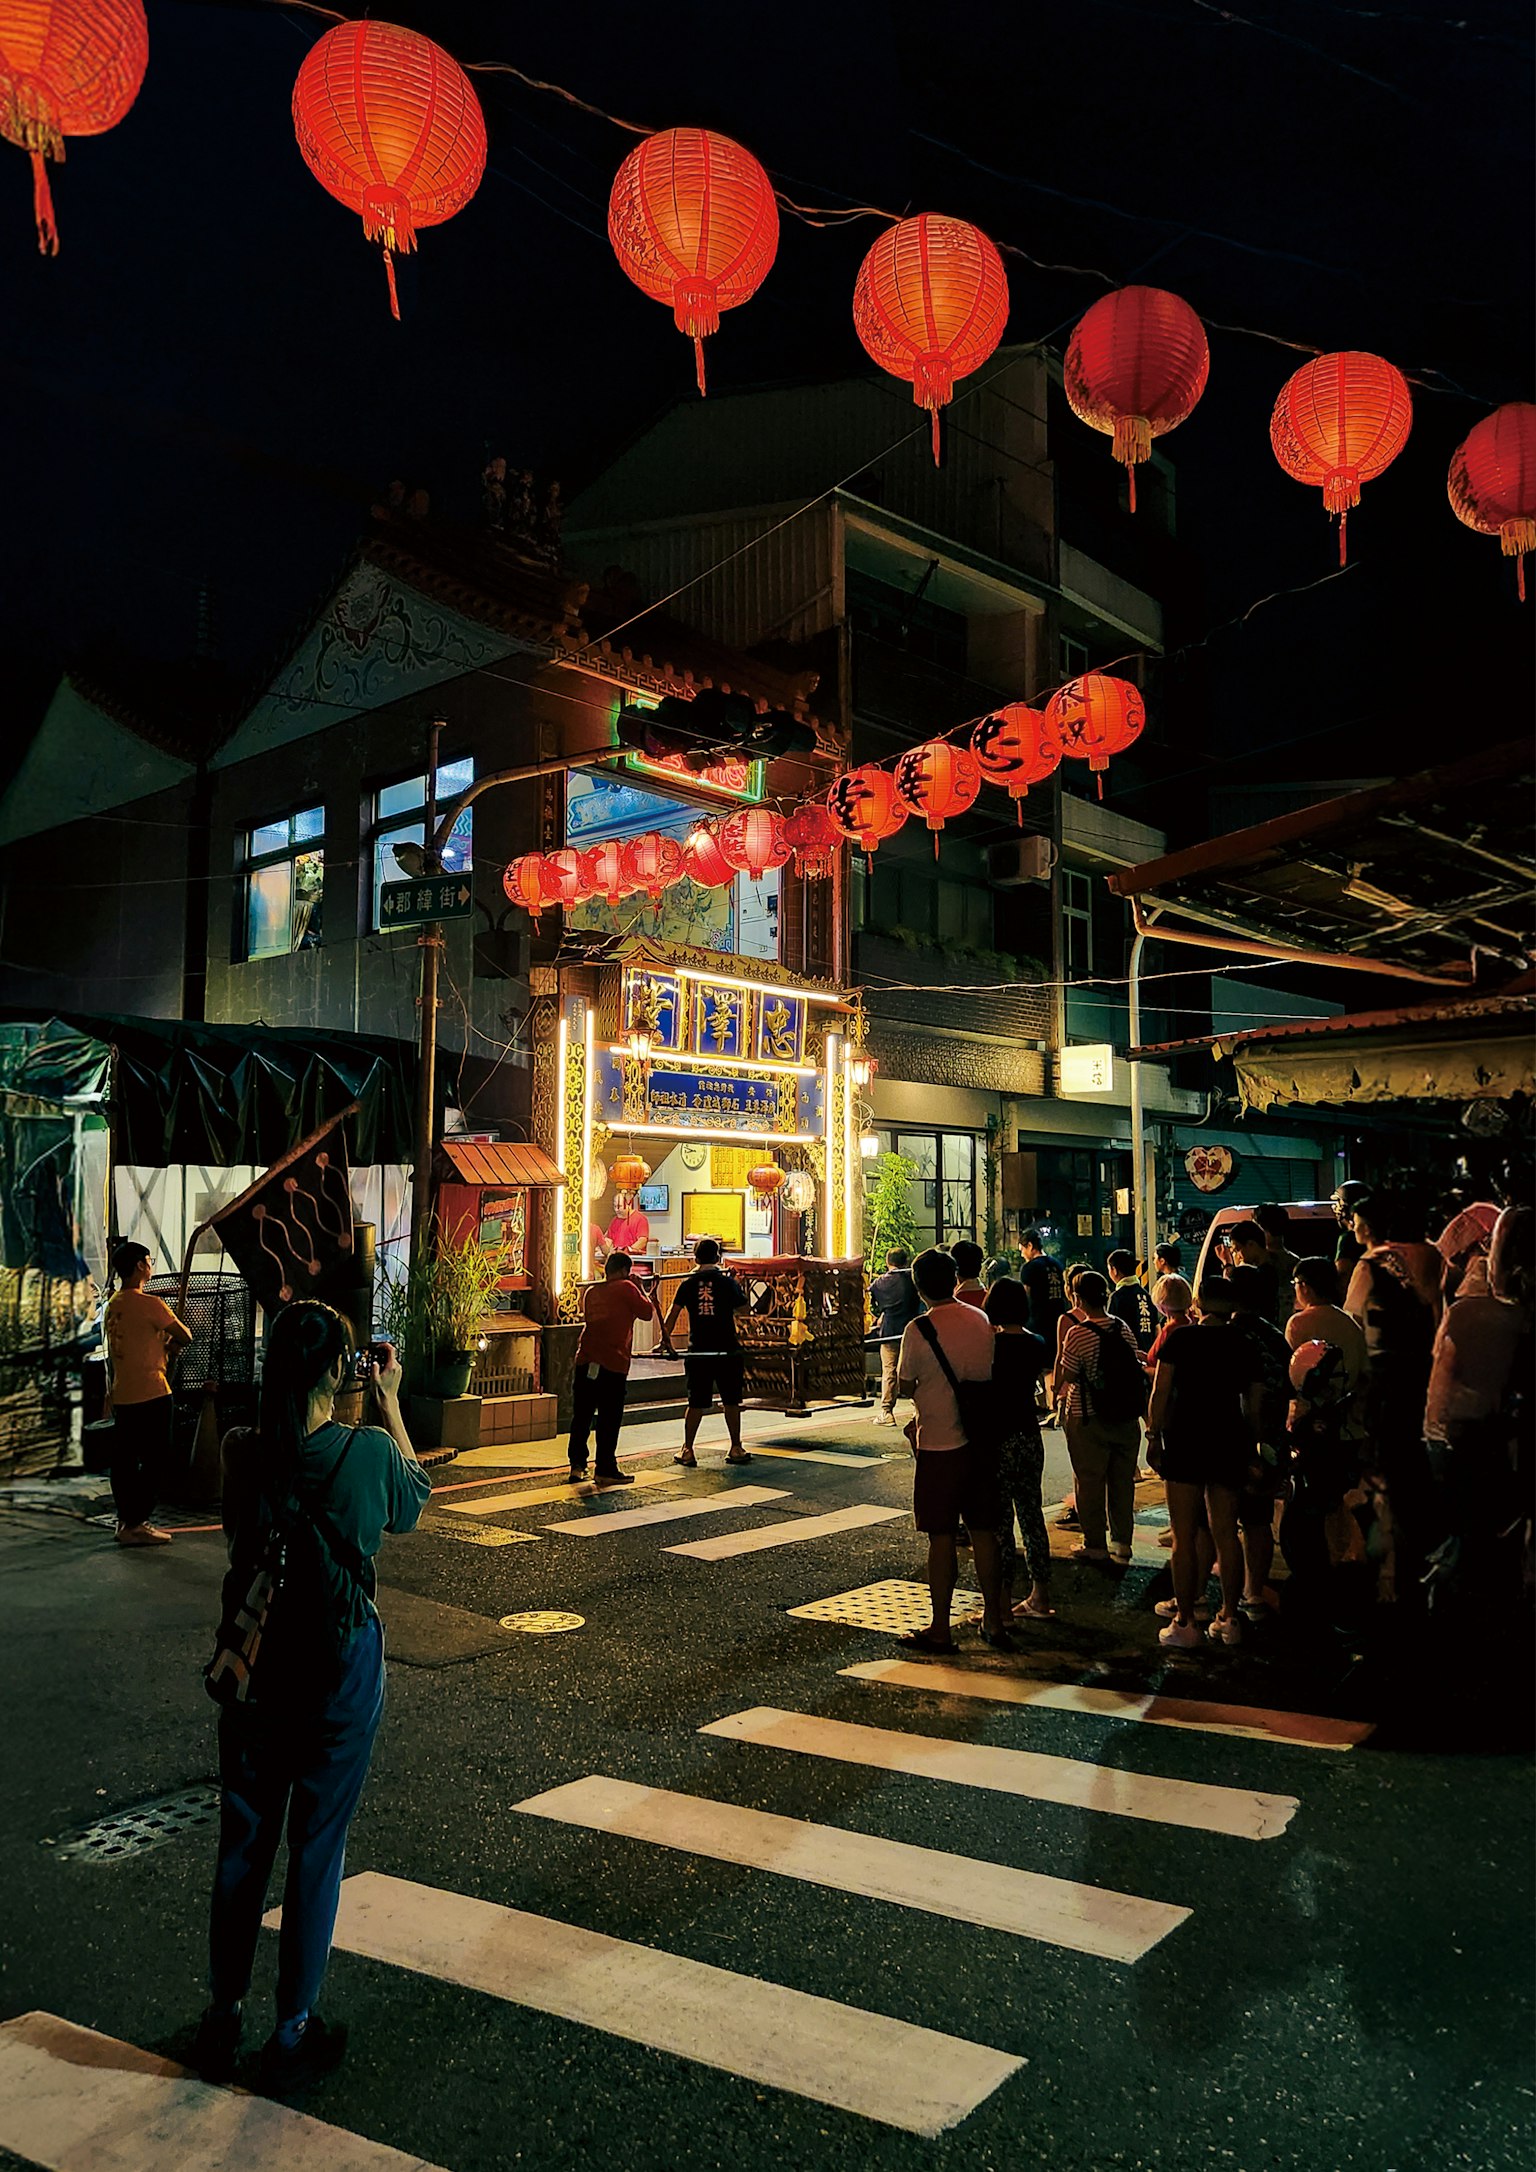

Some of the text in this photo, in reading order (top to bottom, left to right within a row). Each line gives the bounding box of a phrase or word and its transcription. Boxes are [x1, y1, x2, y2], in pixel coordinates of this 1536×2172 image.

[1056, 680, 1105, 748] 恭祝
[396, 886, 456, 913] 郡緯街
